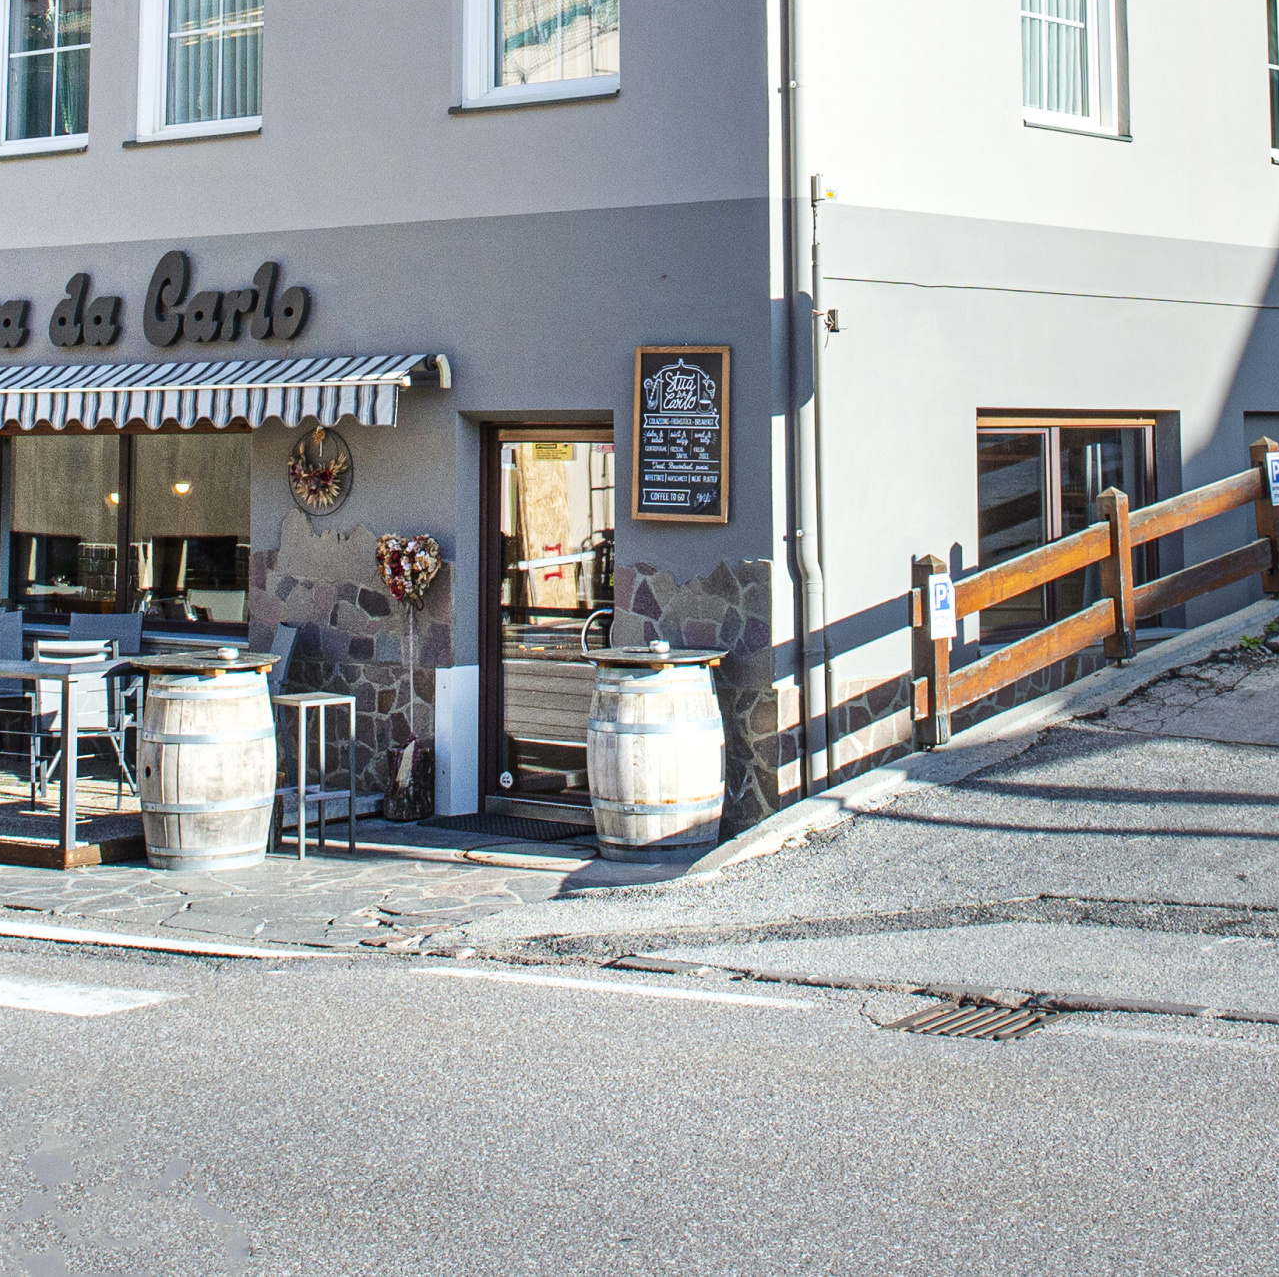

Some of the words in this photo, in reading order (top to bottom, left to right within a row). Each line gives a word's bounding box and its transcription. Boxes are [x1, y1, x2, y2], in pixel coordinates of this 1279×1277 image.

[49, 272, 123, 348] da
[143, 250, 312, 348] Carlo
[665, 371, 697, 393] Stua
[663, 391, 698, 410] Carlo
[650, 492, 669, 501] COFFEE
[670, 492, 677, 501] TO
[677, 493, 686, 502] GO
